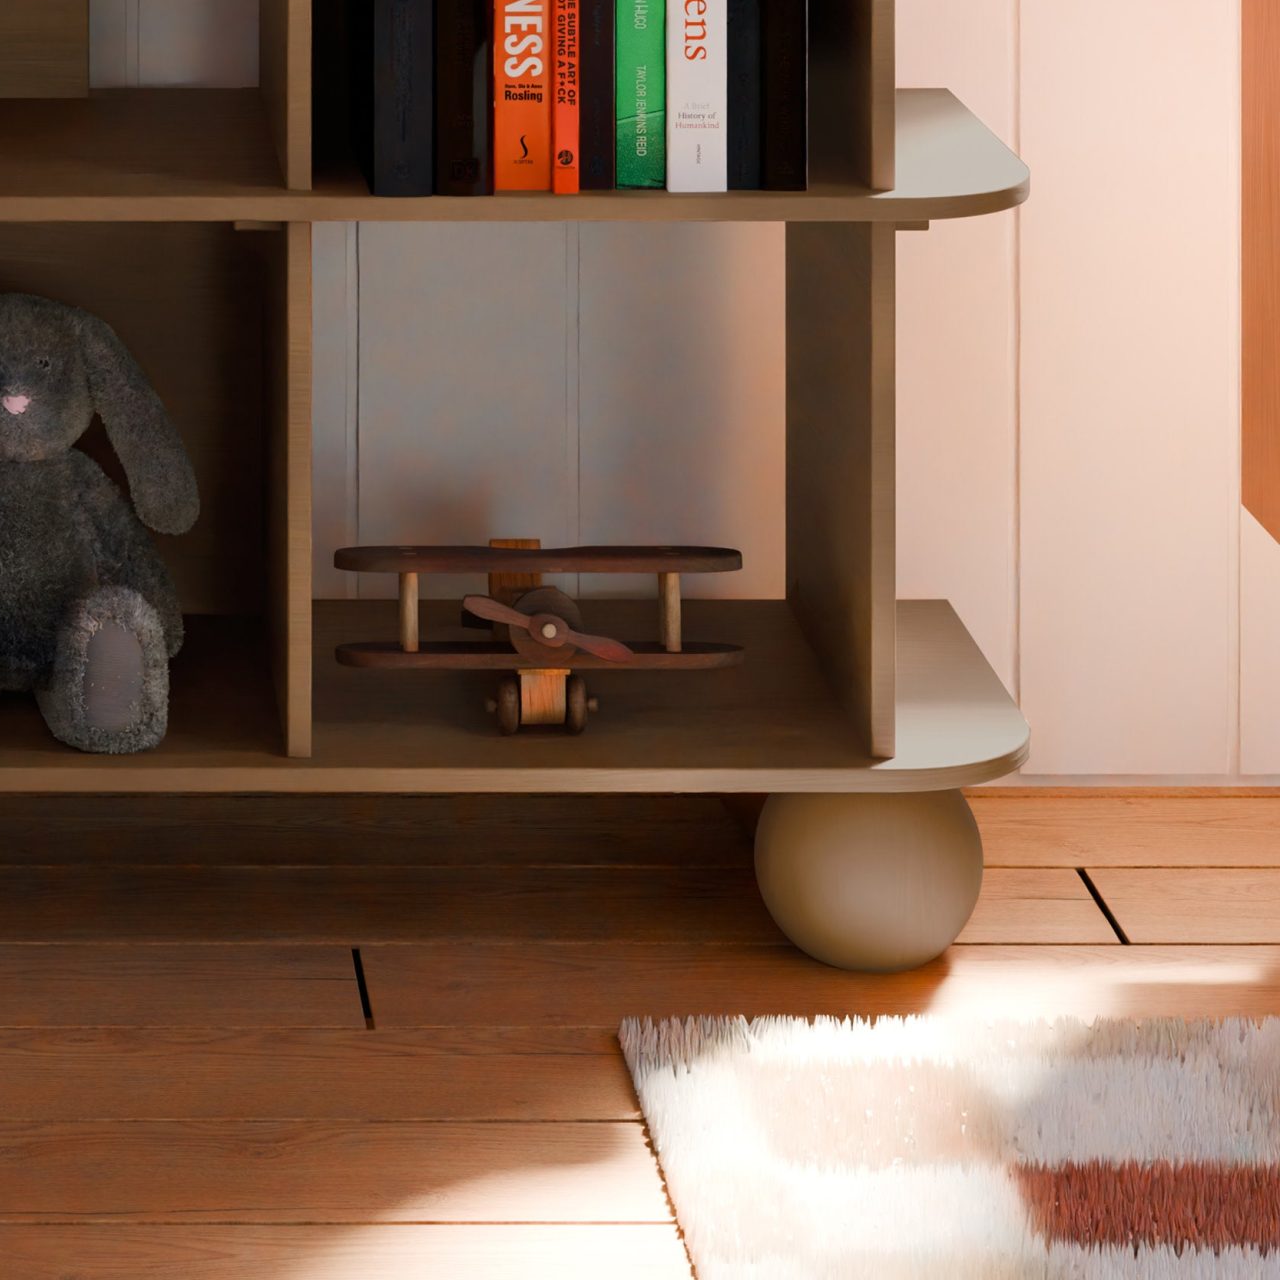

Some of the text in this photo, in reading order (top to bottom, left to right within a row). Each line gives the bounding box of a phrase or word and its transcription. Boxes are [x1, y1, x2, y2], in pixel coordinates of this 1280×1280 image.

[557, 15, 566, 57] GIVING
[567, 13, 576, 58] SUBTLE
[557, 60, 566, 69] A
[567, 62, 576, 86] ART
[504, 90, 543, 103] Rosling
[567, 90, 576, 105] OF
[636, 64, 647, 157] TAYLOR JENKINS REID
[677, 111, 717, 121] History of
[675, 121, 720, 129] Humankind
